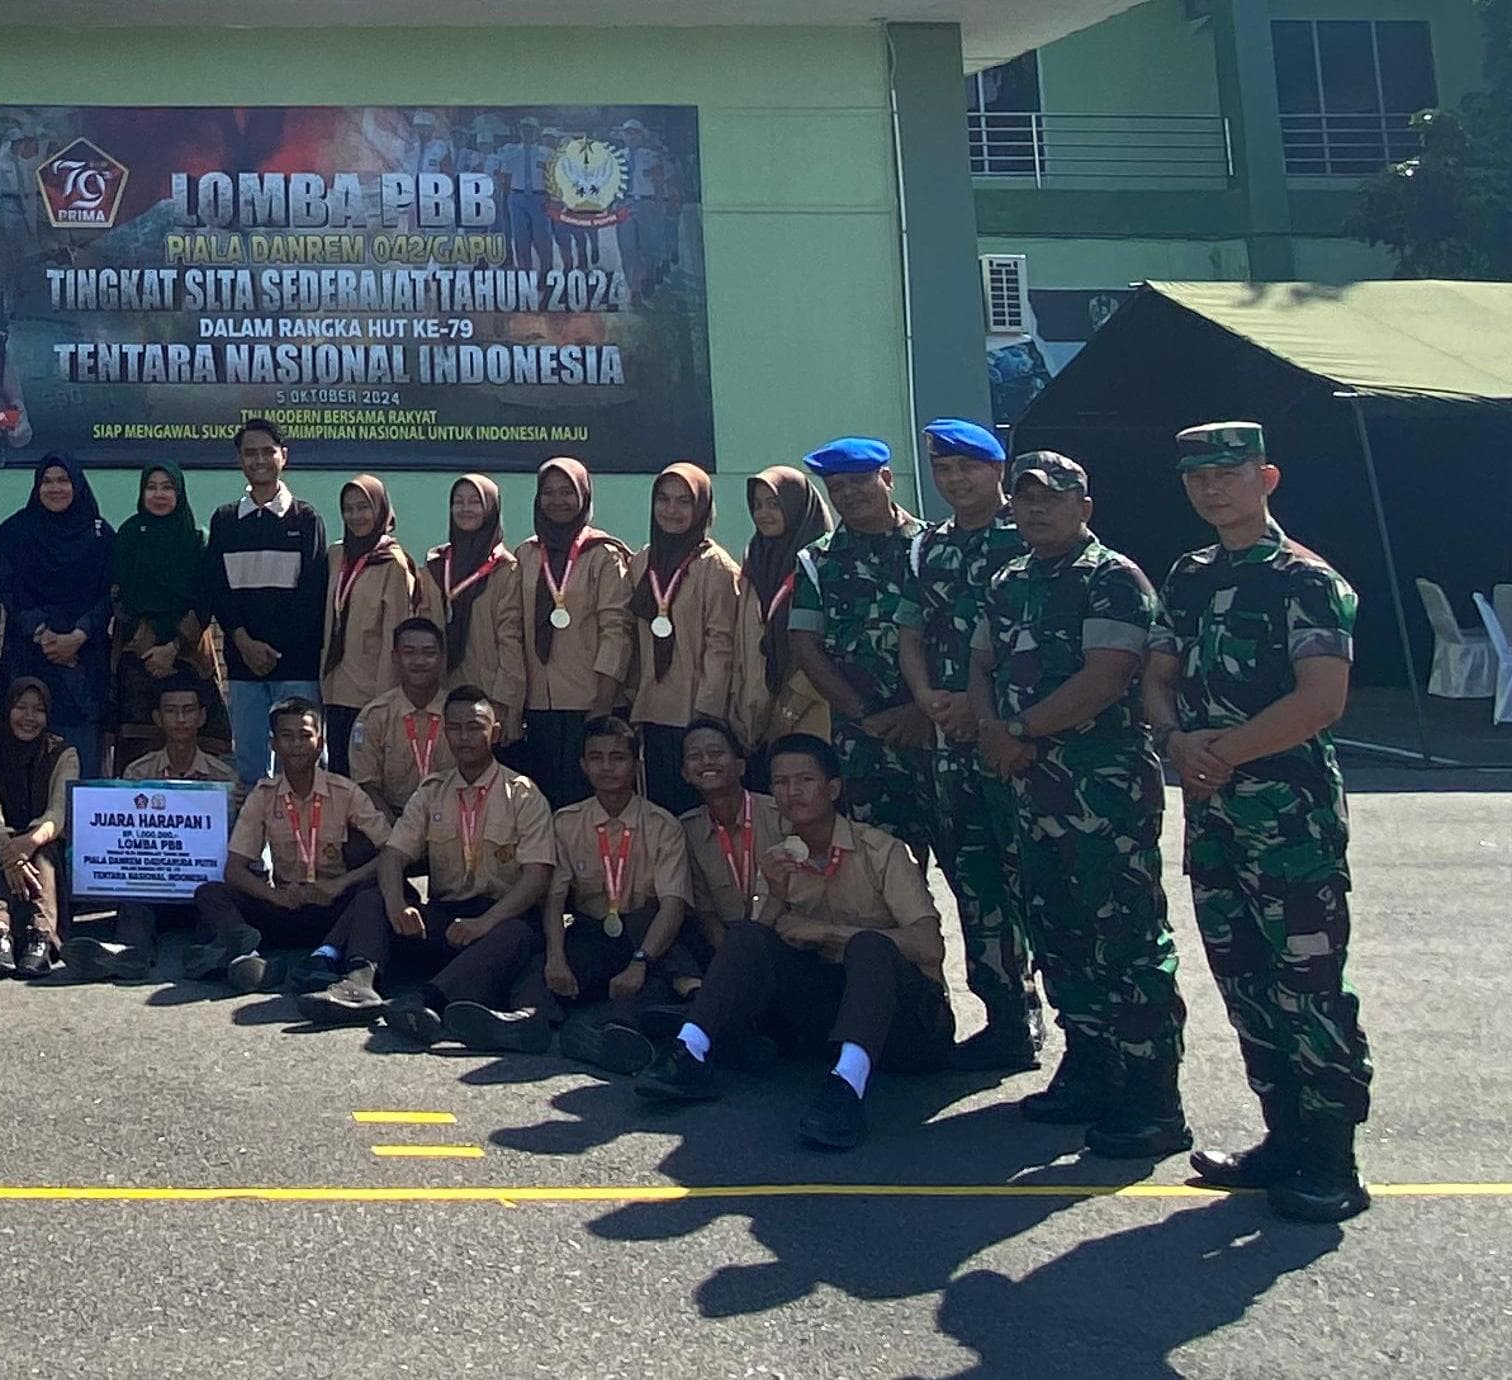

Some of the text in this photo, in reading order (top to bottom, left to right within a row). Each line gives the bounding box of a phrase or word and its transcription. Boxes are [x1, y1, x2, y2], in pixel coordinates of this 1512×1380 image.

[172, 172, 495, 229] LOMBA PBB
[57, 209, 105, 222] PRIMA
[167, 234, 505, 265] PIALA DANREM 042/GAPU
[46, 269, 627, 312] TINGKAT SLTA SEDERAJAT TAHUN 2024
[200, 318, 474, 339] DALAM RANGKA HUT KE-79
[54, 344, 625, 385] TENTARA NASIONAL INDONESIA
[277, 390, 400, 405] 5 OKTOBER 2024
[240, 409, 437, 424] TNI MODERN BERSAMA RAKYAT
[93, 424, 122, 439] SIAP
[125, 424, 199, 439] MENGAWAL
[280, 424, 356, 439] EMIMPINAN
[359, 425, 425, 440] NASIONAL
[428, 425, 473, 440] UNTUK
[476, 425, 548, 440] INDONESIA
[551, 426, 588, 441] MAJU
[90, 813, 135, 828] JUARA
[139, 813, 202, 829] HARAPAN
[118, 838, 183, 850] LOMBA PBB
